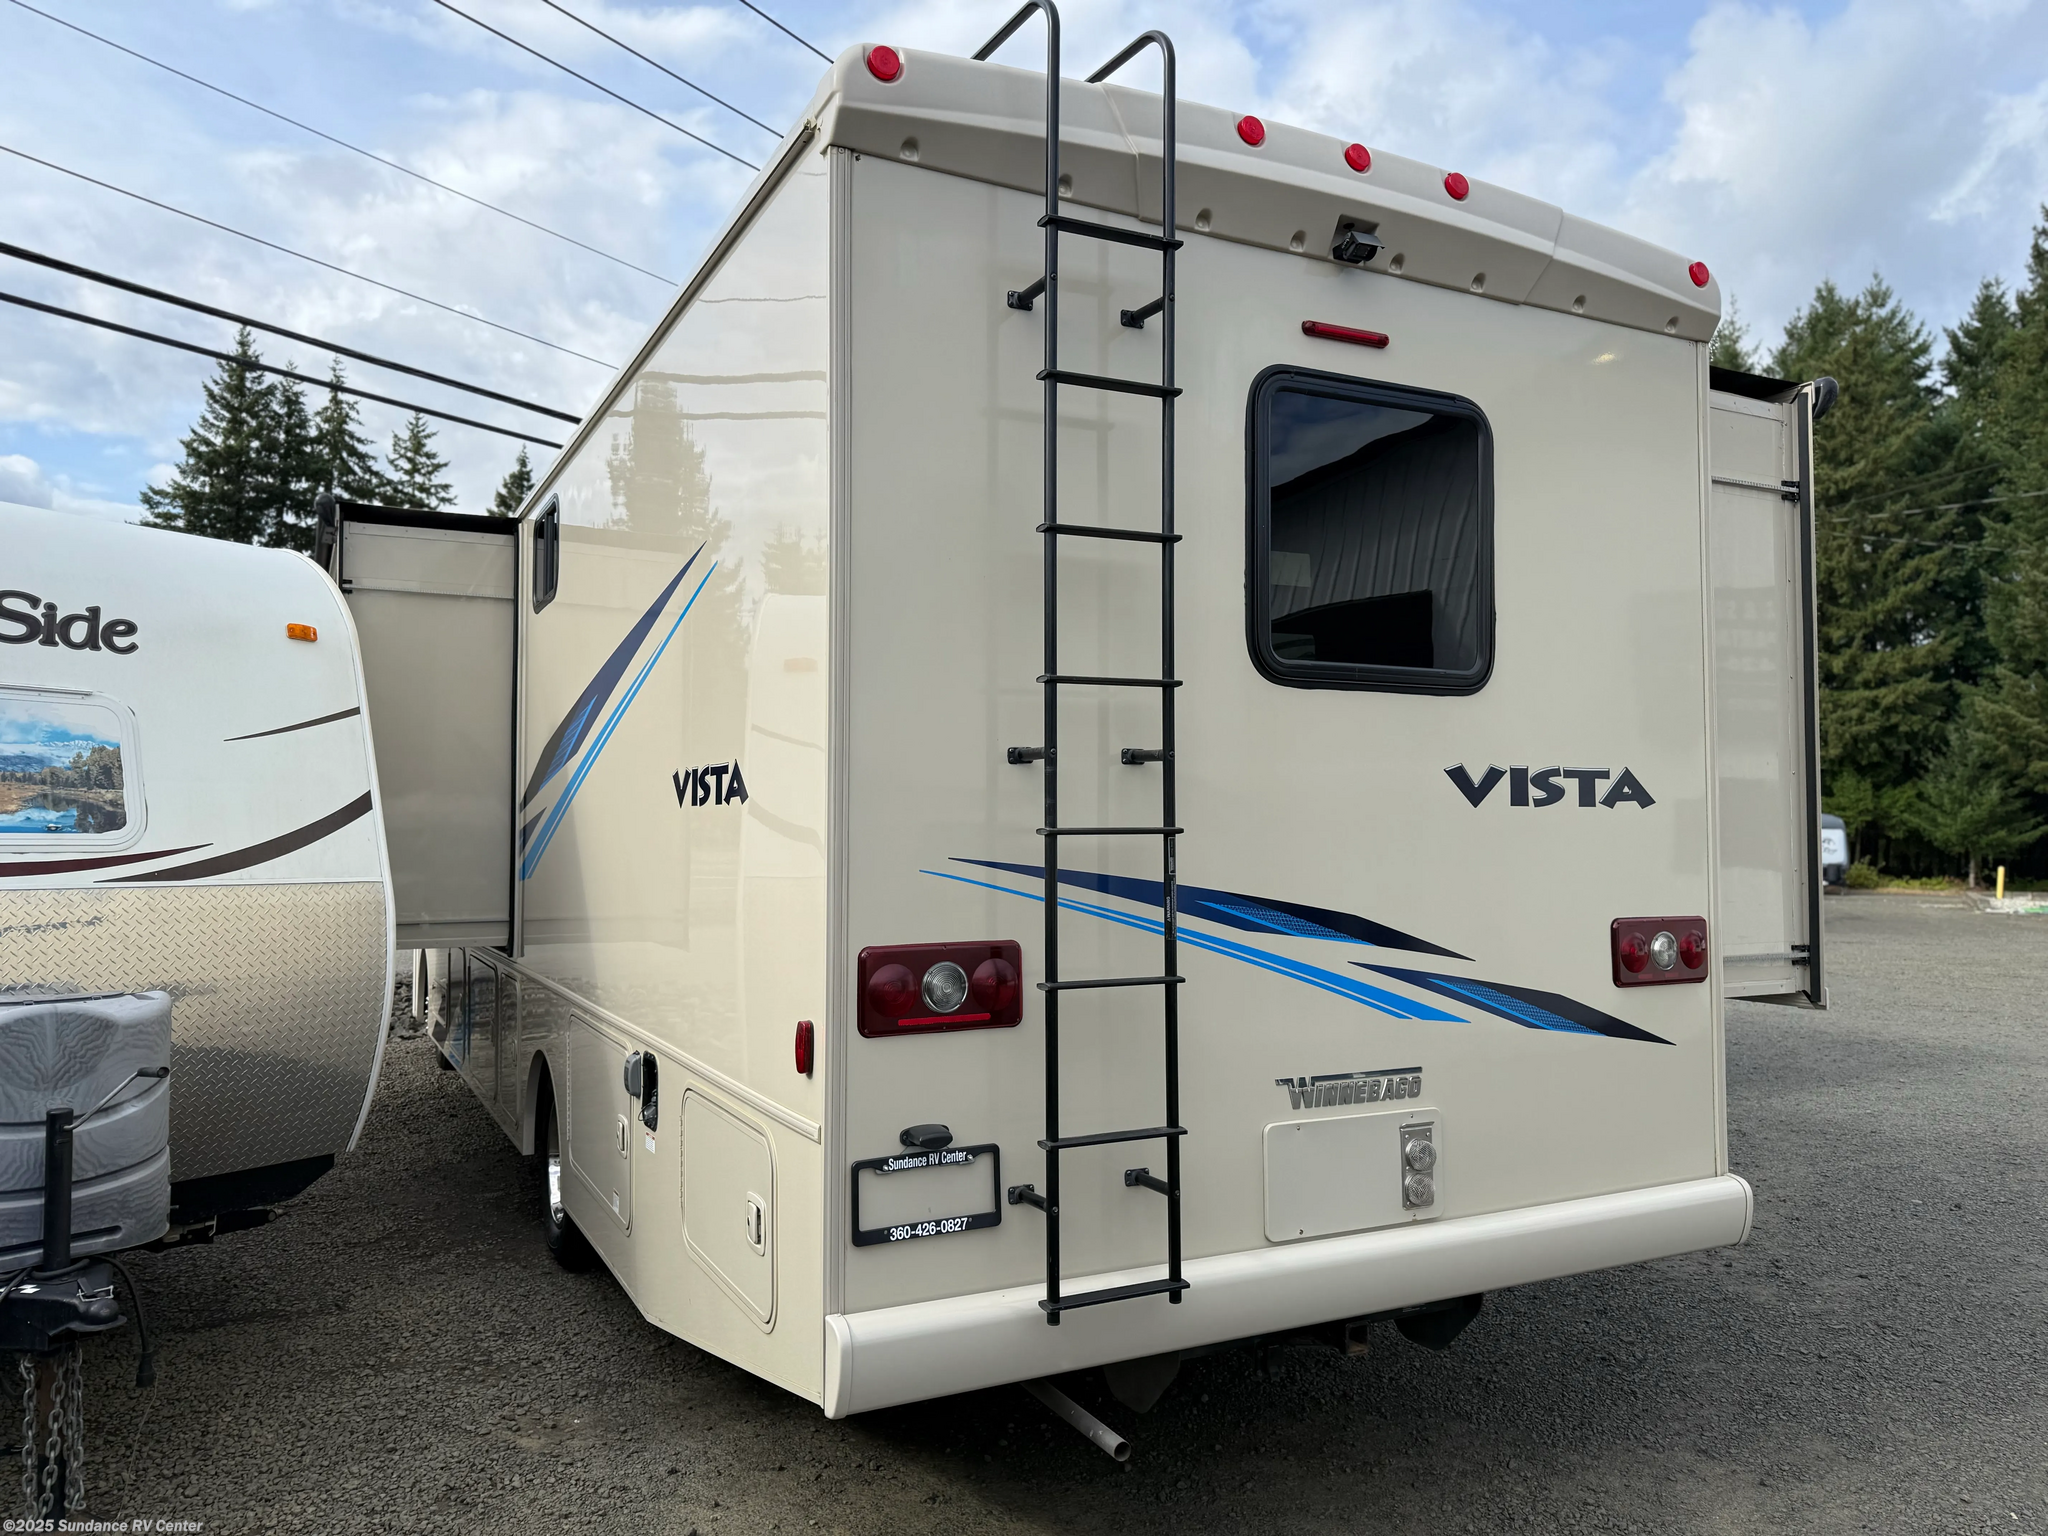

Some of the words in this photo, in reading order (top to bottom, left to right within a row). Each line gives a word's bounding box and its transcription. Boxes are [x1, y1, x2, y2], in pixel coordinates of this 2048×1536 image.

[0, 589, 139, 655] Side
[672, 758, 749, 809] VISTA
[1443, 762, 1656, 809] VISTA
[888, 1156, 926, 1171] Sundance
[928, 1152, 940, 1165] RV
[941, 1151, 966, 1163] Center
[889, 1217, 968, 1241] 360-426-0827
